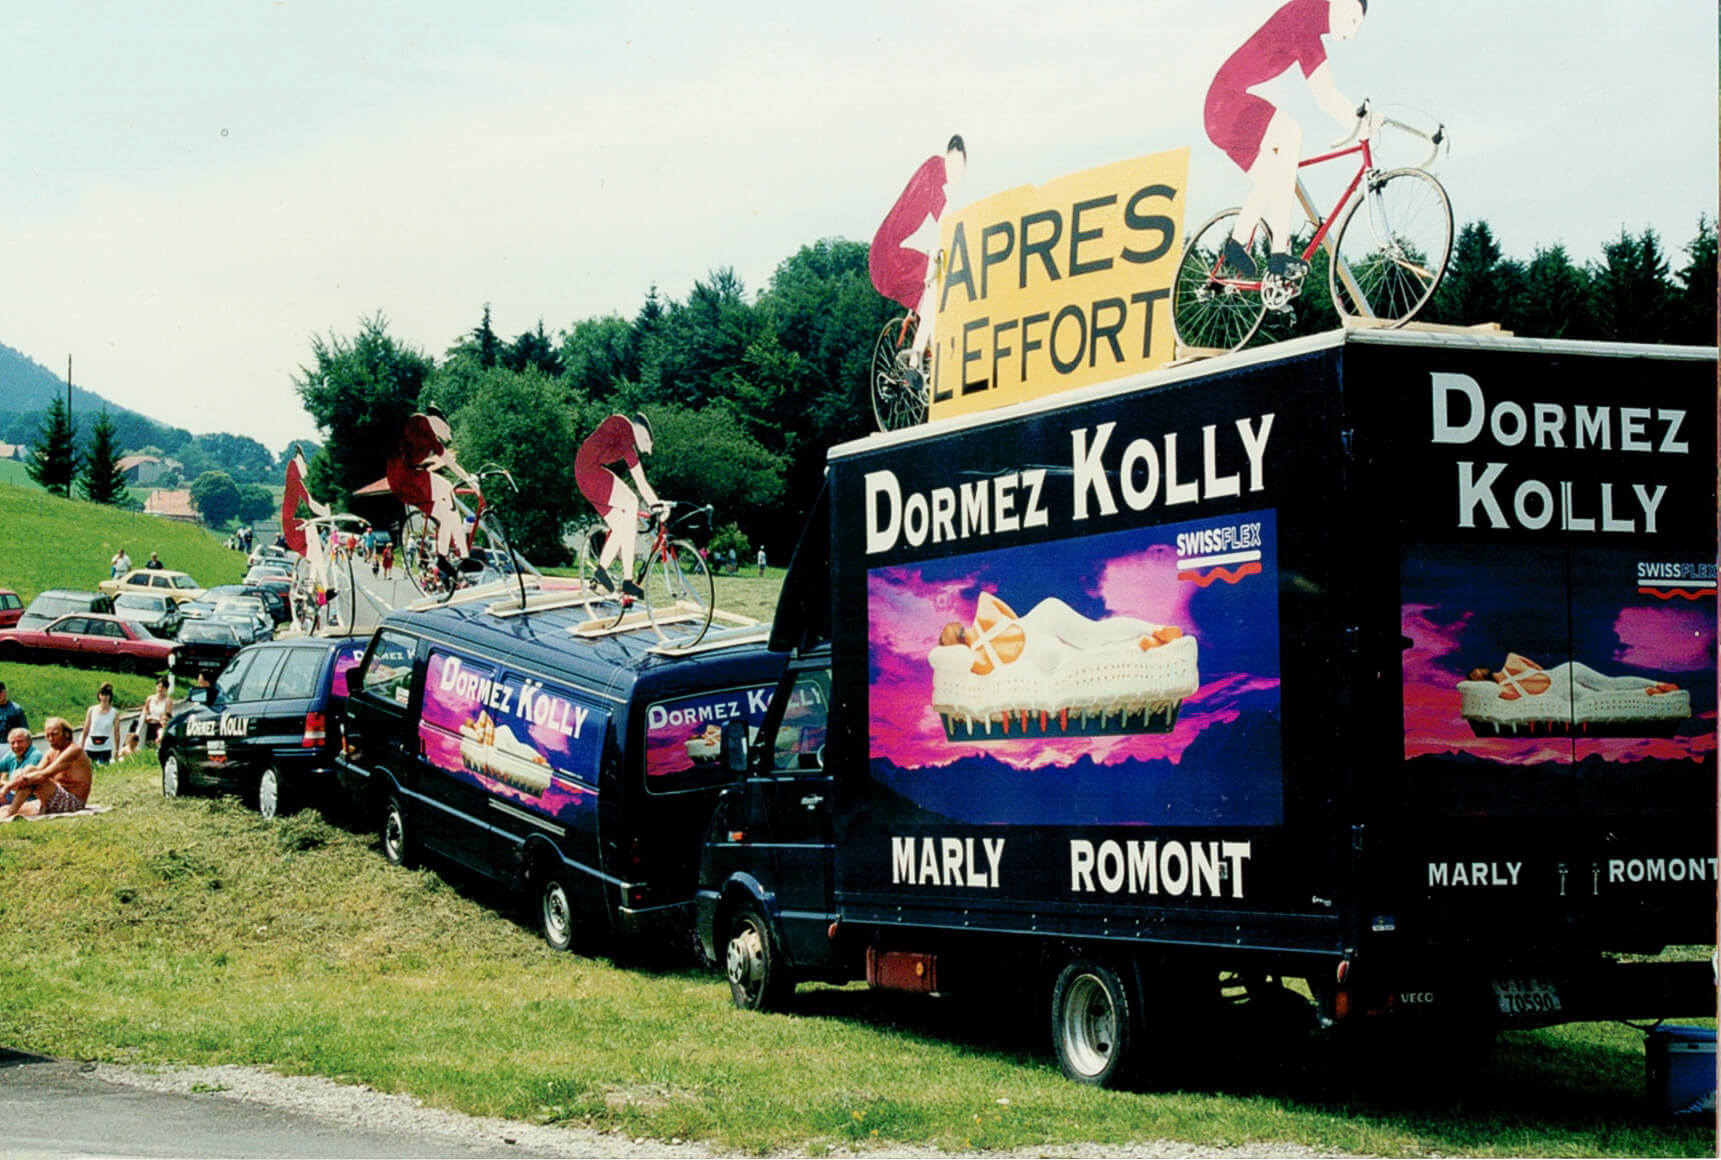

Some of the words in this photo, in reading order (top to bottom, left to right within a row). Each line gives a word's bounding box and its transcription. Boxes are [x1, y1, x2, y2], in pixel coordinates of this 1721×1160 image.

[939, 184, 1178, 313] APRES
[933, 287, 1171, 404] L'EFFORT
[1429, 371, 1689, 454] DORMEZ
[865, 468, 1049, 555] DORMEZ
[1069, 412, 1276, 521] KOLLY
[1456, 460, 1668, 533] KOLLY
[1176, 521, 1262, 557] SWISSFLEX
[440, 655, 514, 715] DORMEZ
[648, 701, 741, 730] DORMEZ
[219, 711, 249, 737] KOLLY
[891, 836, 1006, 889] MARLY
[1070, 839, 1251, 899] ROMONT
[1427, 861, 1523, 888] MARLY
